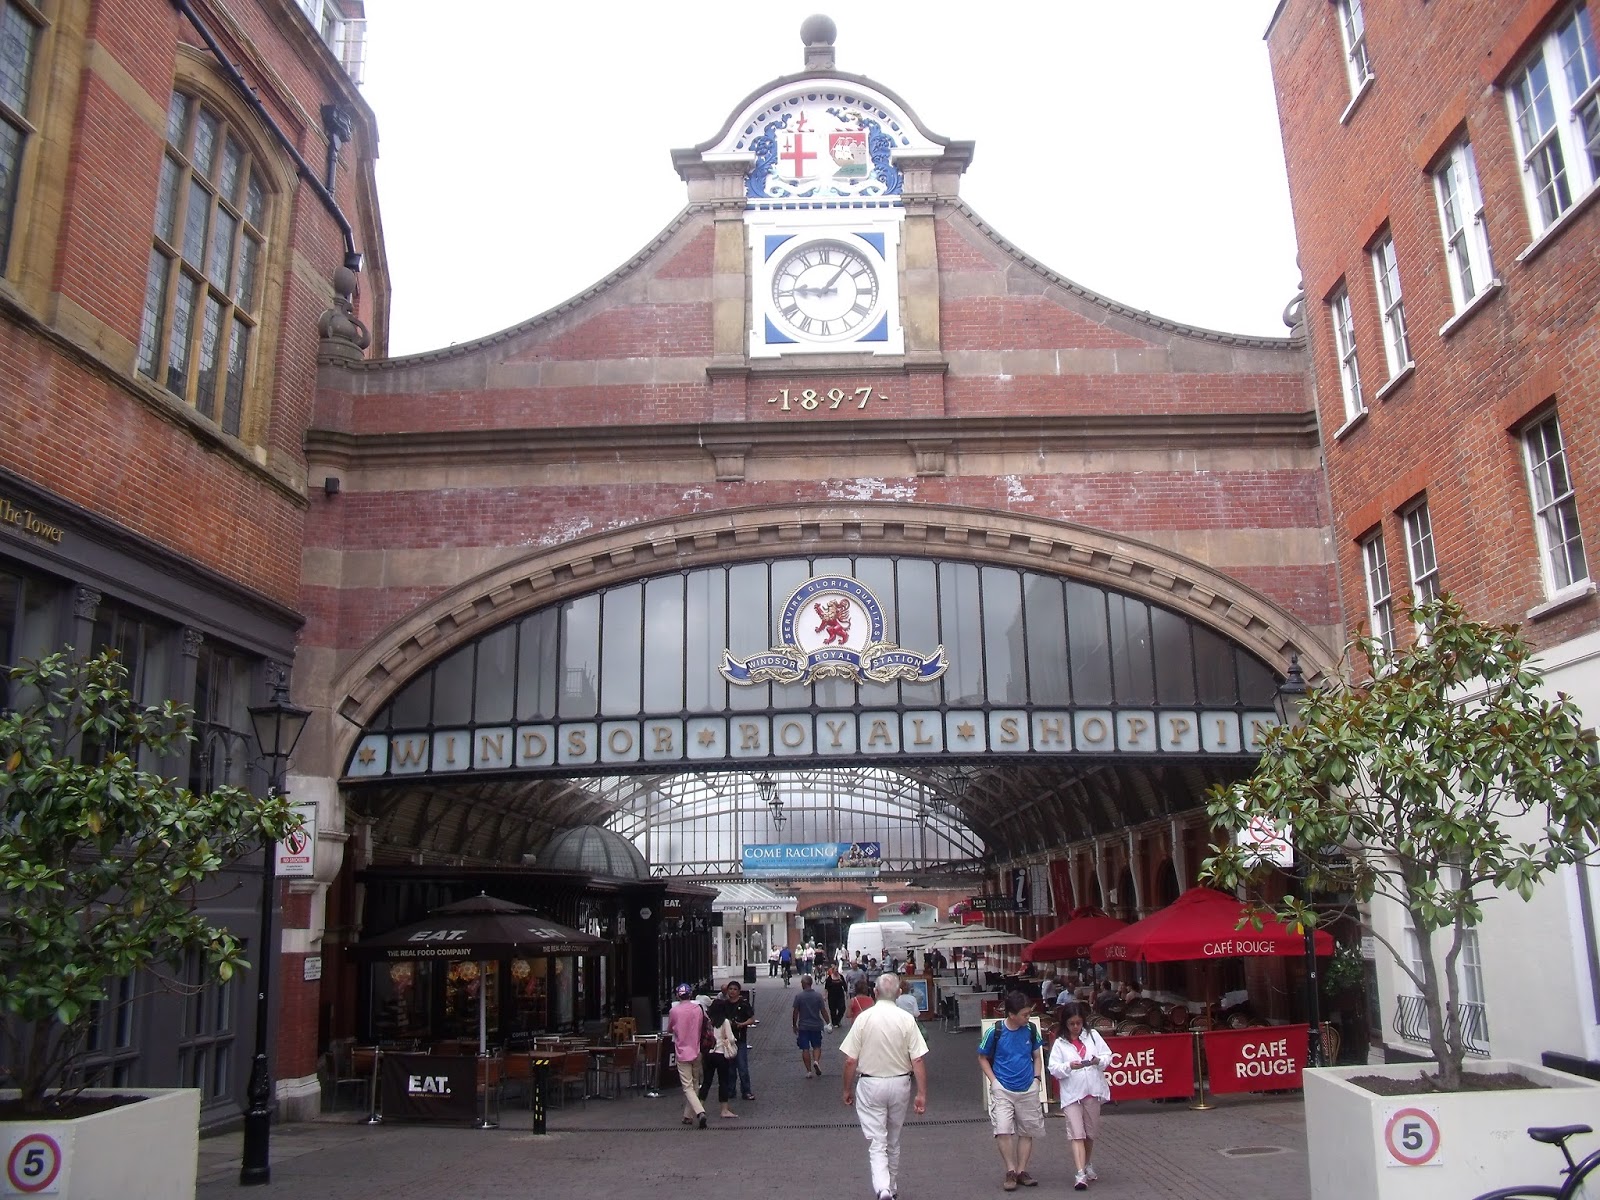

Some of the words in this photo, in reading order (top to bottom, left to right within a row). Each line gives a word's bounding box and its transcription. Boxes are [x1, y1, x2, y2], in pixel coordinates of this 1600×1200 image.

[24, 509, 64, 542] Tower
[784, 595, 803, 639] SERVIRE
[808, 580, 849, 592] GLORIA
[855, 588, 880, 636] QUALITAS
[748, 657, 796, 670] WINDSOR
[815, 651, 852, 662] ROYAL
[872, 656, 922, 667] STATION
[391, 725, 674, 766] WINDSOR
[739, 718, 934, 749] ROYAL
[1000, 717, 1273, 745] SHOPPIN
[744, 847, 782, 858] COME
[785, 847, 838, 858] RACING!
[663, 899, 681, 907] EAT.
[407, 929, 468, 942] EAT.
[400, 949, 416, 957] REAL
[436, 948, 471, 956] COMPANY
[1076, 946, 1090, 956] CA
[1203, 940, 1233, 956] CAFÉ
[1236, 941, 1275, 954] ROUGE
[1109, 1048, 1155, 1069] CAFÉ
[1241, 1039, 1288, 1060] CAFÉ
[1103, 1068, 1163, 1087] ROUGE
[1235, 1058, 1296, 1079] ROUGE
[408, 1074, 451, 1093] EAT.
[1402, 1122, 1423, 1150] 5
[23, 1149, 45, 1177] 5
